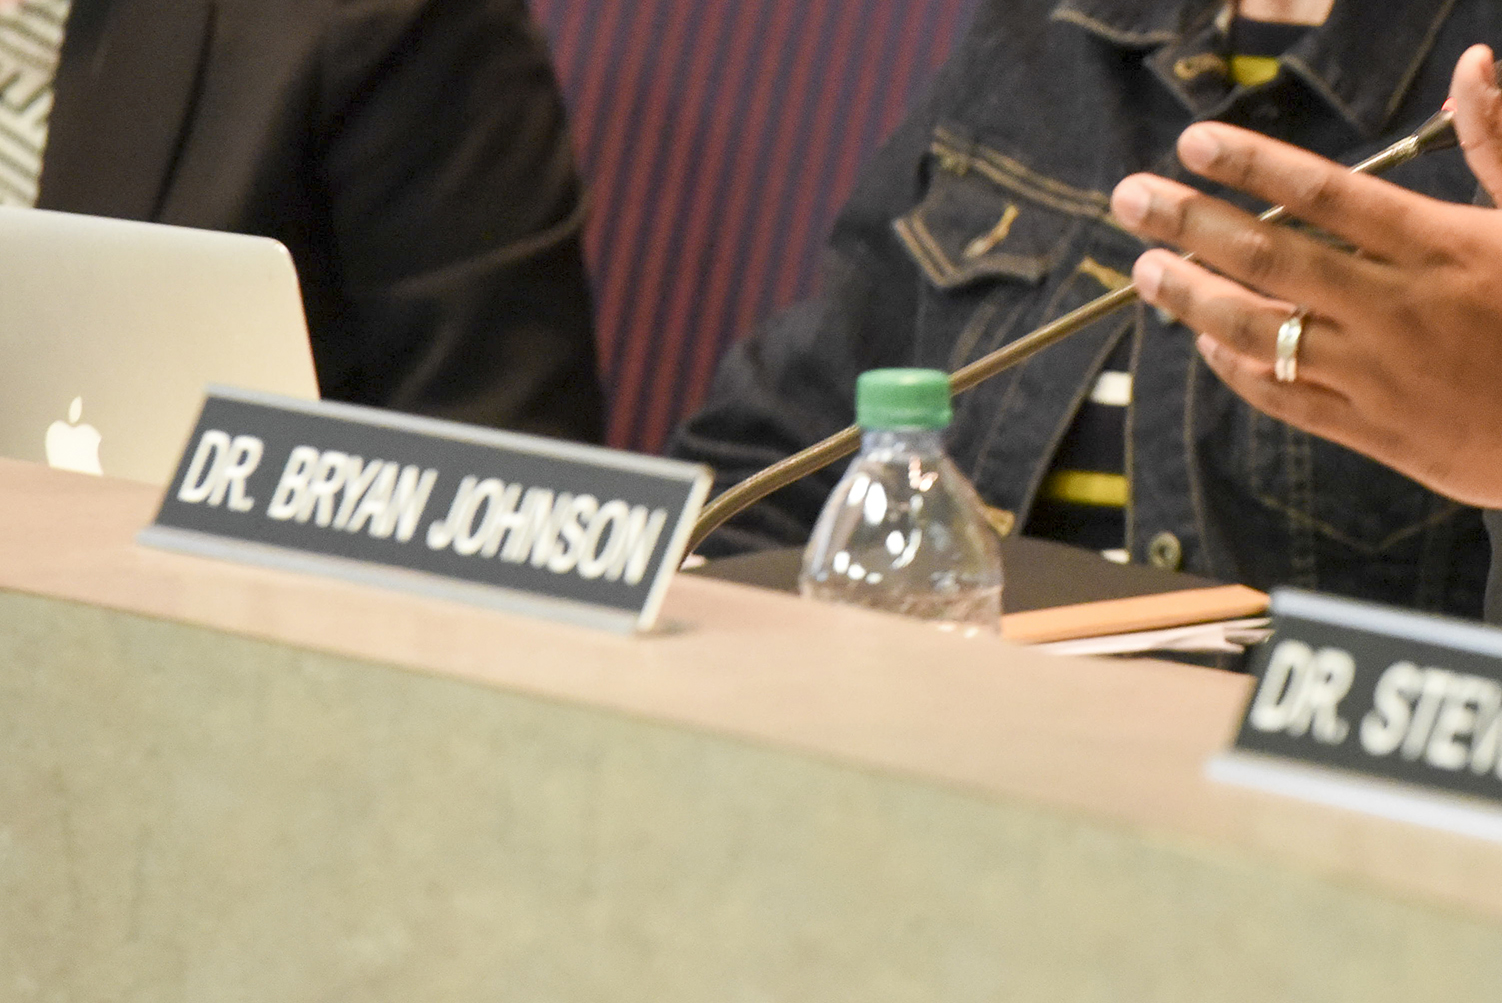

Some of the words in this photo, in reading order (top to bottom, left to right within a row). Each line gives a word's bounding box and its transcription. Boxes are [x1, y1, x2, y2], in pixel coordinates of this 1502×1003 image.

[177, 430, 263, 512] DR.
[268, 446, 436, 543] BRYAN
[428, 474, 667, 585] JOHNSON
[1250, 640, 1355, 746] DR.
